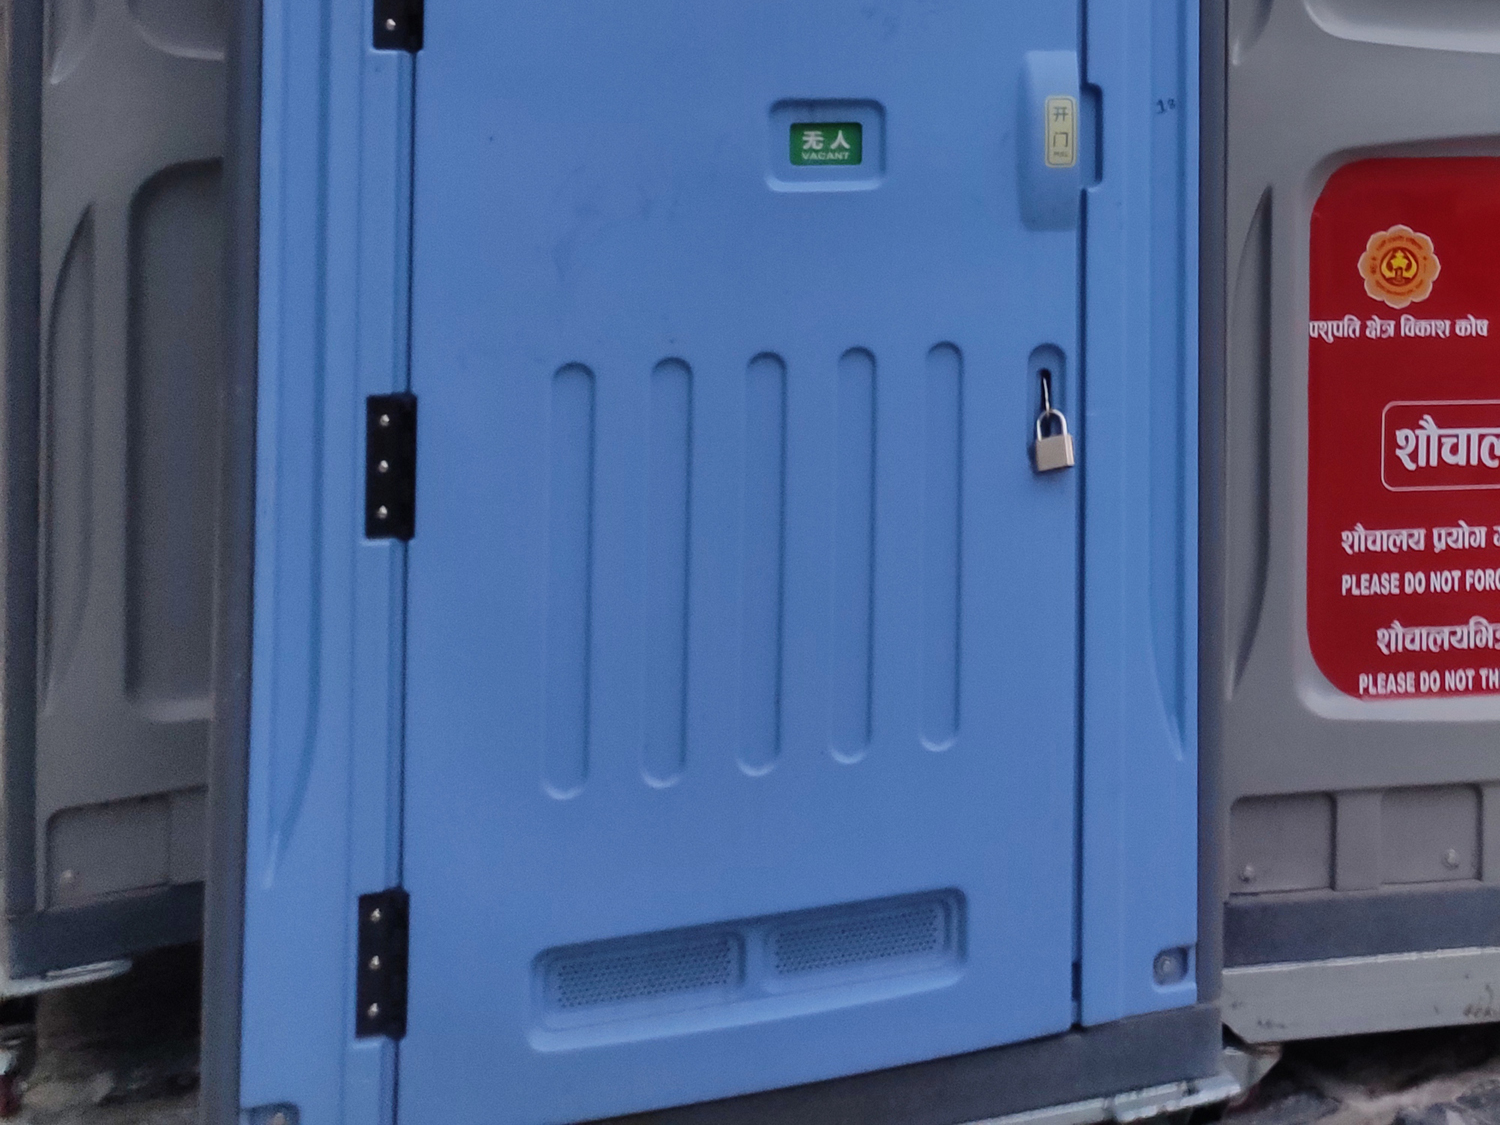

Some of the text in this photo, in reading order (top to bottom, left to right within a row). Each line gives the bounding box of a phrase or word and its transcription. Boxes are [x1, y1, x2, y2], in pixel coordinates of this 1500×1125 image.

[802, 130, 851, 149] 无人
[801, 151, 850, 160] VACANT
[1309, 314, 1362, 344] पशुपति
[1365, 315, 1396, 339] क्षेत्र
[1455, 313, 1489, 338] कोष
[1341, 522, 1427, 555] शौचालय
[1432, 520, 1488, 553] प्रयोग
[1341, 573, 1400, 596] PLEASE
[1404, 571, 1426, 595] DO
[1430, 569, 1462, 593] NOT
[1359, 672, 1416, 696] PLEASE
[1419, 670, 1441, 693] DO
[1444, 668, 1475, 691] NOT
